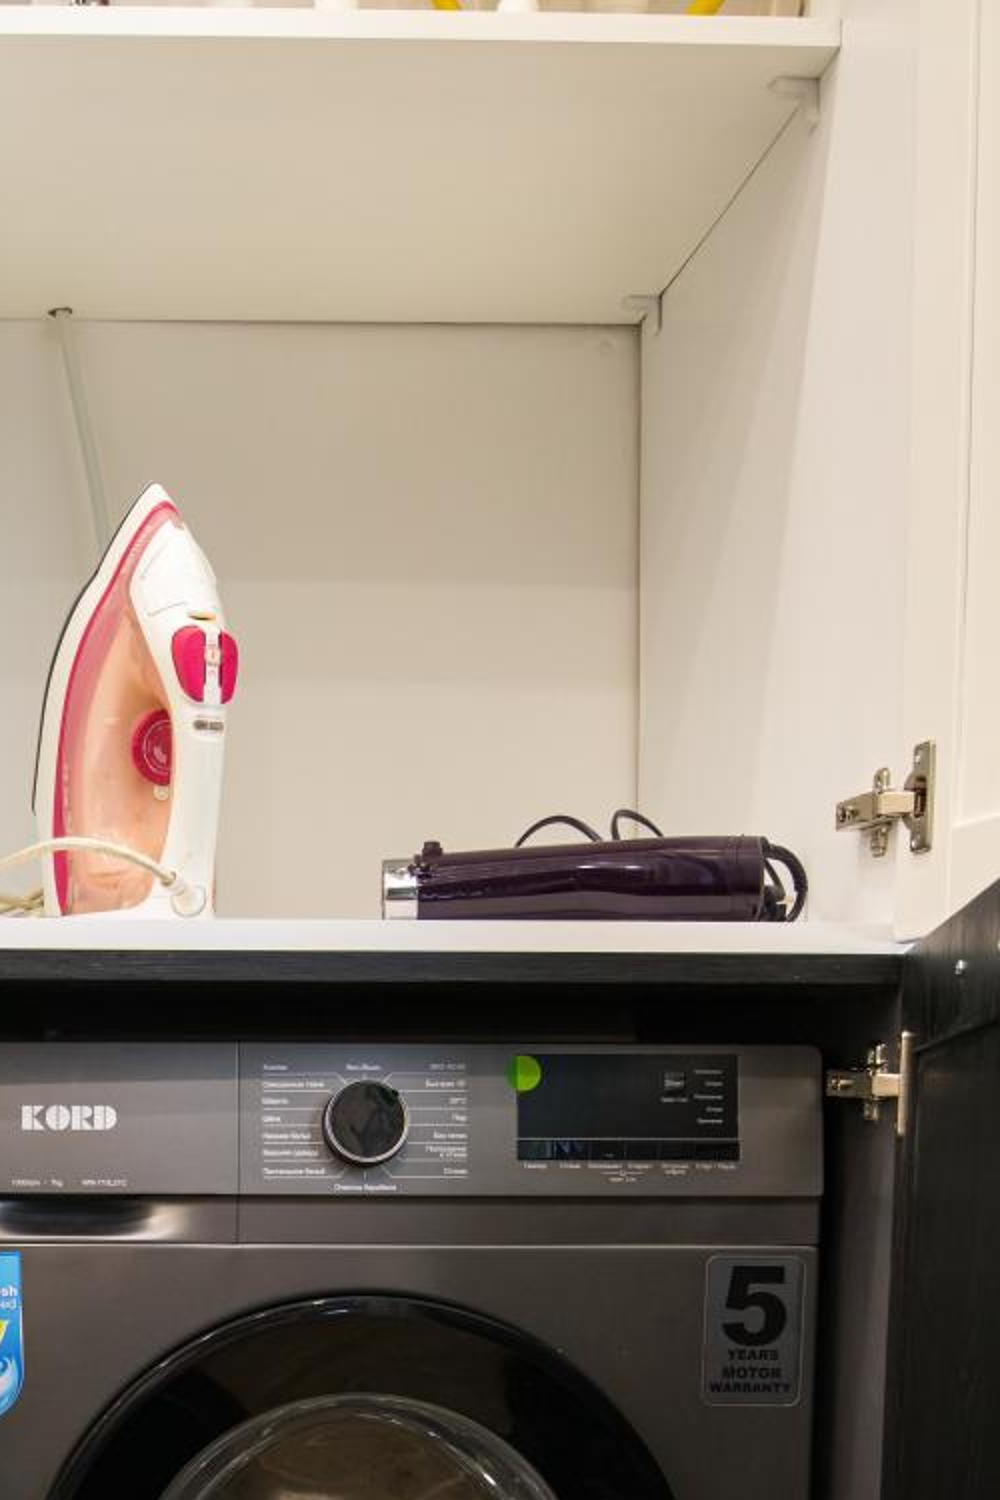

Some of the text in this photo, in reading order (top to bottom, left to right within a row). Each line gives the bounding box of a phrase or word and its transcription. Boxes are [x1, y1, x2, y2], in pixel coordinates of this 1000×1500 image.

[21, 1105, 117, 1131] KORD
[722, 1266, 787, 1347] 5
[728, 1350, 779, 1361] YEARS
[722, 1367, 782, 1379] MOTOR
[710, 1381, 792, 1393] WARRANTY
